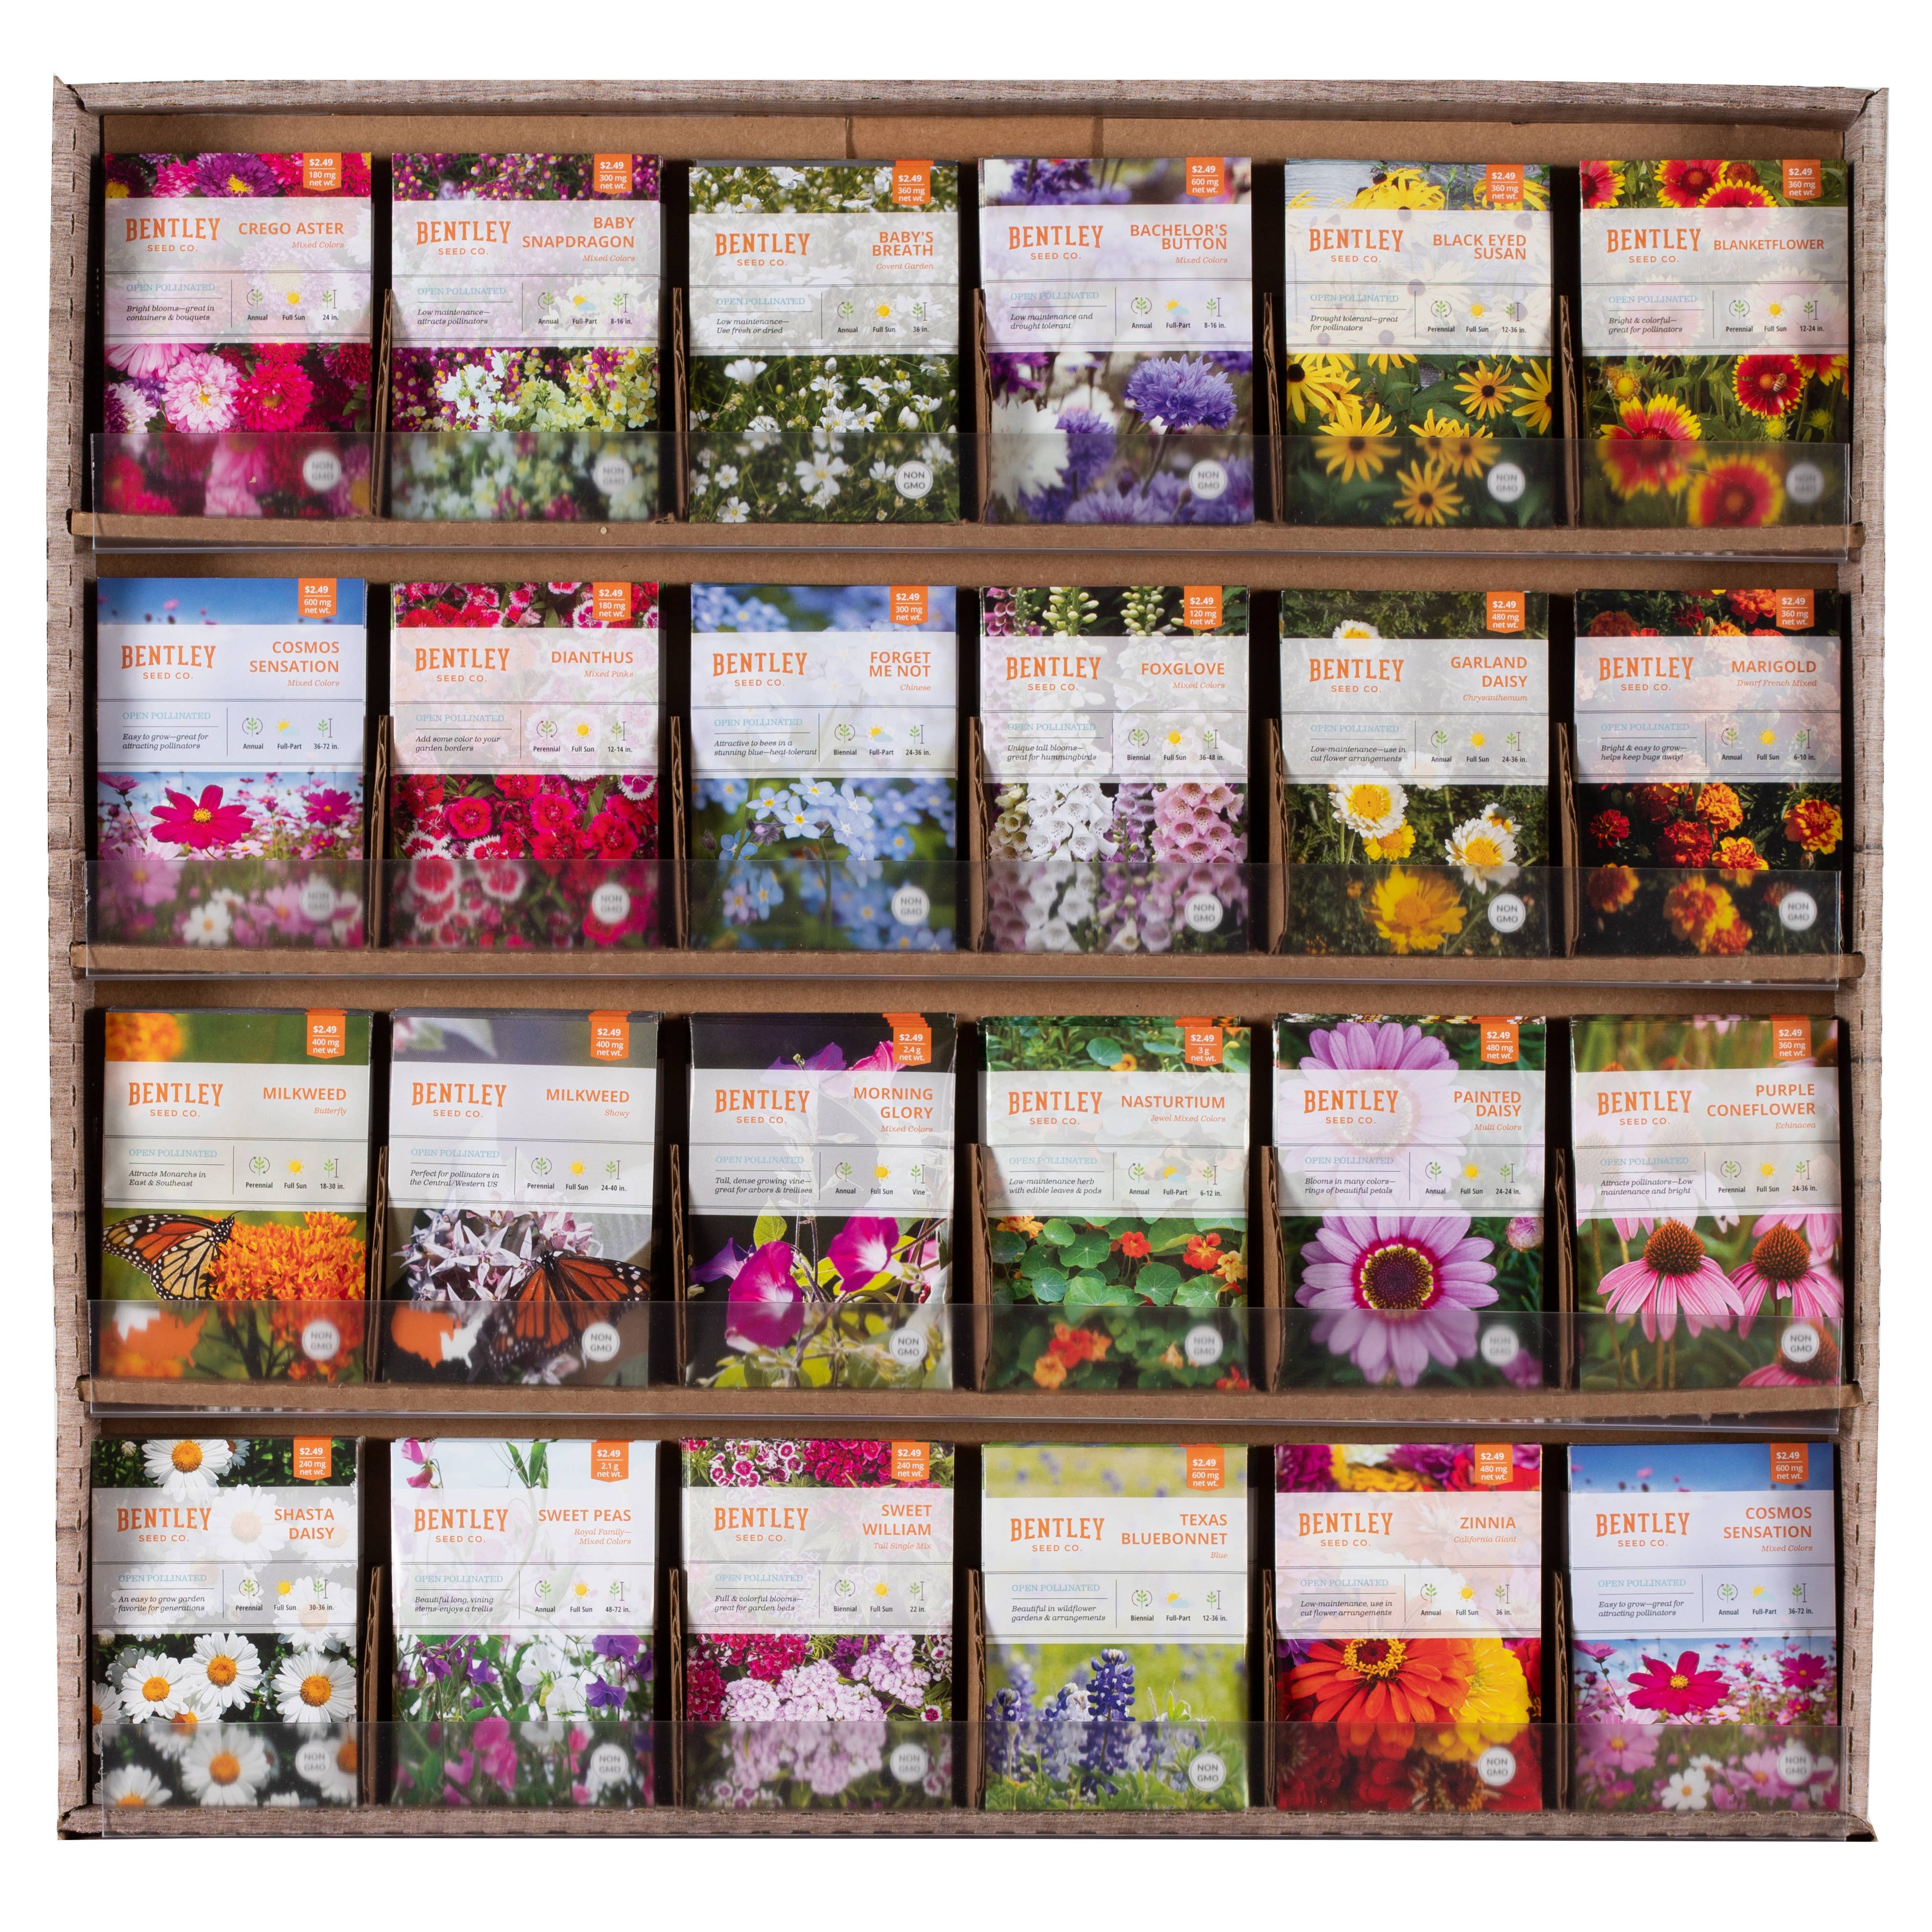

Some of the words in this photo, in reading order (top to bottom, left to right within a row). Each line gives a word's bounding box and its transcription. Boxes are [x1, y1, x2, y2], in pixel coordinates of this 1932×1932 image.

[309, 158, 333, 166] $2.49
[1192, 165, 1215, 174] $2.49
[1789, 168, 1812, 176] $2.49
[899, 175, 922, 183] $2.49
[1492, 172, 1515, 180] $2.49
[239, 223, 291, 235] CREGO
[296, 223, 344, 235] ASTER
[594, 217, 635, 229] BABY
[125, 218, 220, 242] BENTLEY
[416, 221, 511, 245] BENTLEY
[1131, 225, 1227, 236] BACHELOR'S
[522, 236, 634, 248] SNAPDRAGON
[880, 231, 934, 244] BABY'S
[1009, 225, 1103, 250] BENTLEY
[1309, 229, 1403, 252] BENTLEY
[1433, 234, 1482, 246] BLACK
[1488, 234, 1526, 246] EYED
[1607, 228, 1701, 253] BENTLEY
[715, 233, 810, 256] BENTLEY
[1162, 238, 1227, 250] BUTTON
[1714, 239, 1824, 250] BLANKETFLOWER
[873, 245, 933, 256] BREATH
[1474, 247, 1526, 260] SUSAN
[176, 315, 210, 323] bouquets
[732, 327, 752, 336] fresh
[305, 585, 328, 594] $2.49
[599, 589, 623, 597] $2.49
[896, 593, 920, 601] $2.49
[1190, 597, 1213, 605] $2.49
[1492, 601, 1516, 609] $2.49
[272, 642, 339, 653] COSMOS
[121, 646, 216, 669] BENTLEY
[415, 648, 510, 672] BENTLEY
[552, 651, 633, 663] DIANTHUS
[871, 651, 931, 664] FORGET
[1451, 656, 1527, 669] GARLAND
[249, 660, 339, 673] SENSATION
[713, 653, 808, 676] BENTLEY
[1006, 657, 1101, 680] BENTLEY
[1142, 663, 1224, 675] FOXGLOVE
[1309, 659, 1404, 682] BENTLEY
[1599, 657, 1694, 681] BENTLEY
[1732, 661, 1817, 673] MARIGOLD
[870, 665, 892, 677] ME
[897, 665, 931, 677] NOT
[1482, 675, 1528, 688] DAISY
[1463, 694, 1528, 702] Chrysanthemum
[597, 1028, 621, 1036] $2.49
[899, 1033, 922, 1042] $2.49
[1486, 1031, 1510, 1039] $2.49
[1778, 1029, 1802, 1037] $2.49
[129, 1082, 223, 1107] BENTLEY
[263, 1087, 346, 1101] MILKWEED
[412, 1082, 507, 1107] BENTLEY
[547, 1088, 630, 1103] MILKWEED
[854, 1087, 933, 1100] MORNING
[1756, 1084, 1815, 1097] PURPLE
[715, 1090, 810, 1113] BENTLEY
[1121, 1096, 1225, 1108] NASTURTIUM
[1304, 1090, 1398, 1114] BENTLEY
[1454, 1091, 1521, 1103] PAINTED
[1597, 1090, 1692, 1116] BENTLEY
[1009, 1092, 1102, 1115] BENTLEY
[1707, 1102, 1816, 1117] CONEFLOWER
[314, 1107, 347, 1115] Butterfly
[605, 1109, 630, 1118] Showy
[880, 1106, 933, 1119] GLORY
[1476, 1105, 1522, 1117] DAISY
[299, 1447, 323, 1456] $2.49
[597, 1449, 620, 1458] $2.49
[898, 1449, 921, 1457] $2.49
[1776, 1452, 1799, 1460] $2.49
[274, 1509, 334, 1521] SHASTA
[539, 1510, 589, 1522] SWEET
[594, 1509, 631, 1522] PEAS
[881, 1505, 932, 1517] SWEET
[1746, 1506, 1812, 1519] COSMOS
[117, 1508, 211, 1532] BENTLEY
[414, 1509, 508, 1532] BENTLEY
[714, 1507, 809, 1531] BENTLEY
[1180, 1514, 1227, 1526] TEXAS
[1299, 1512, 1393, 1537] BENTLEY
[1460, 1517, 1516, 1529] ZINNIA
[1596, 1512, 1690, 1537] BENTLEY
[289, 1528, 334, 1540] DAISY
[862, 1524, 931, 1536] WILLIAM
[1010, 1518, 1104, 1542] BENTLEY
[1724, 1526, 1812, 1539] SENSATION
[1122, 1533, 1227, 1545] BLUEBONNET
[118, 1604, 146, 1613] favorite
[147, 1604, 159, 1613] for
